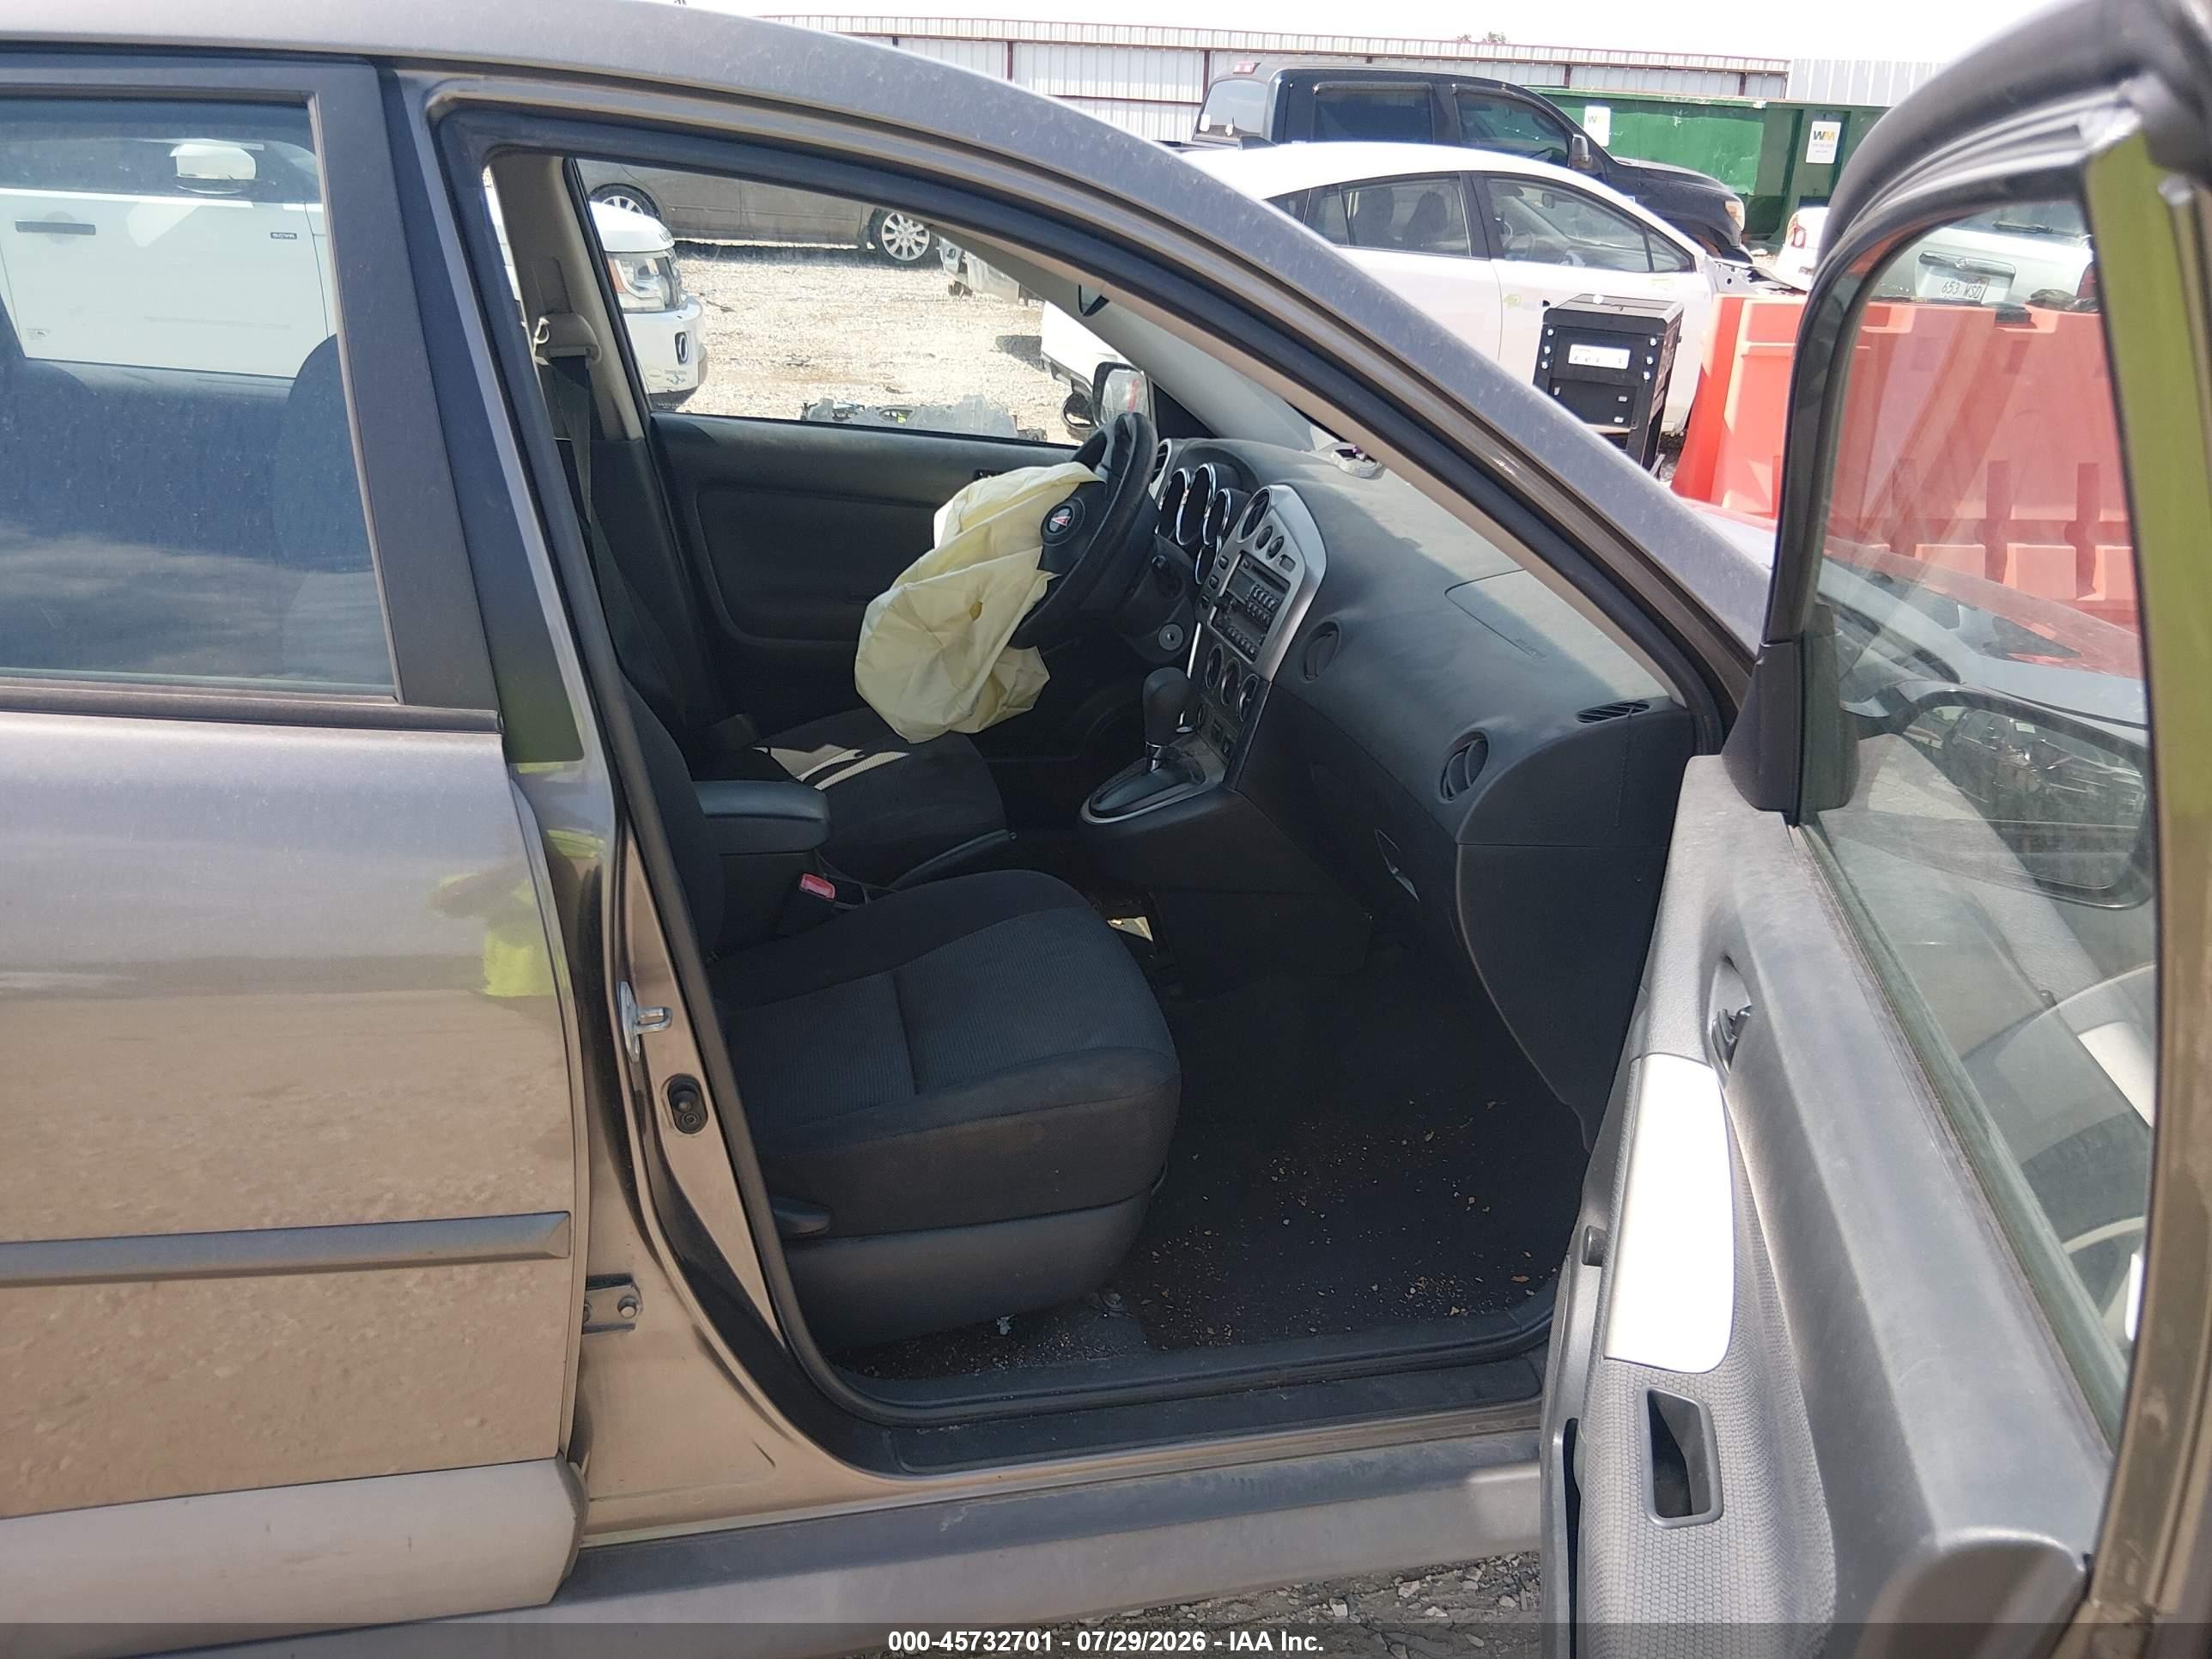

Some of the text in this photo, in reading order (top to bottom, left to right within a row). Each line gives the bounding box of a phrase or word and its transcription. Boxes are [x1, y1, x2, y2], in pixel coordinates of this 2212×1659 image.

[1813, 130, 1835, 141] WM
[1941, 281, 1983, 299] 653 WSD
